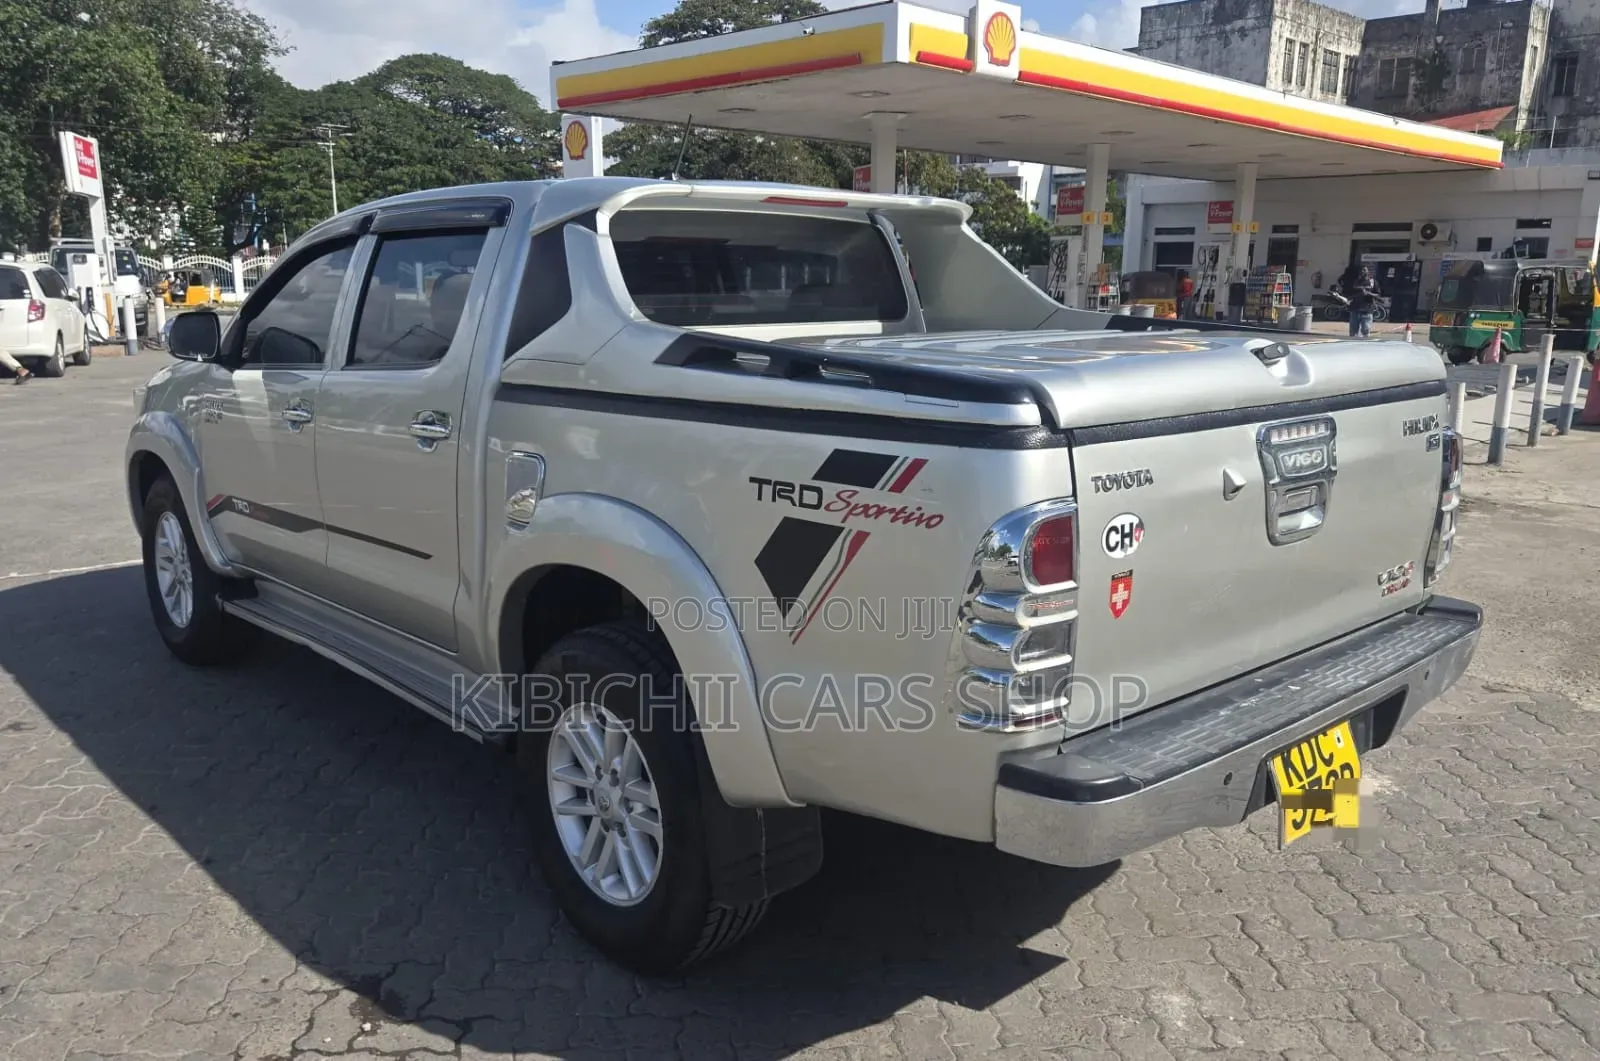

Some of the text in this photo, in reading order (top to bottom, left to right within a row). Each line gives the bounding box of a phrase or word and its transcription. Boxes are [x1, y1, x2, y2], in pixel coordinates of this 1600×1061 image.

[1283, 450, 1323, 468] VIGO
[1090, 469, 1154, 494] TOYOTA
[749, 476, 945, 529] TRD Sportivo
[1105, 522, 1134, 553] CH
[1280, 731, 1334, 788] KDC
